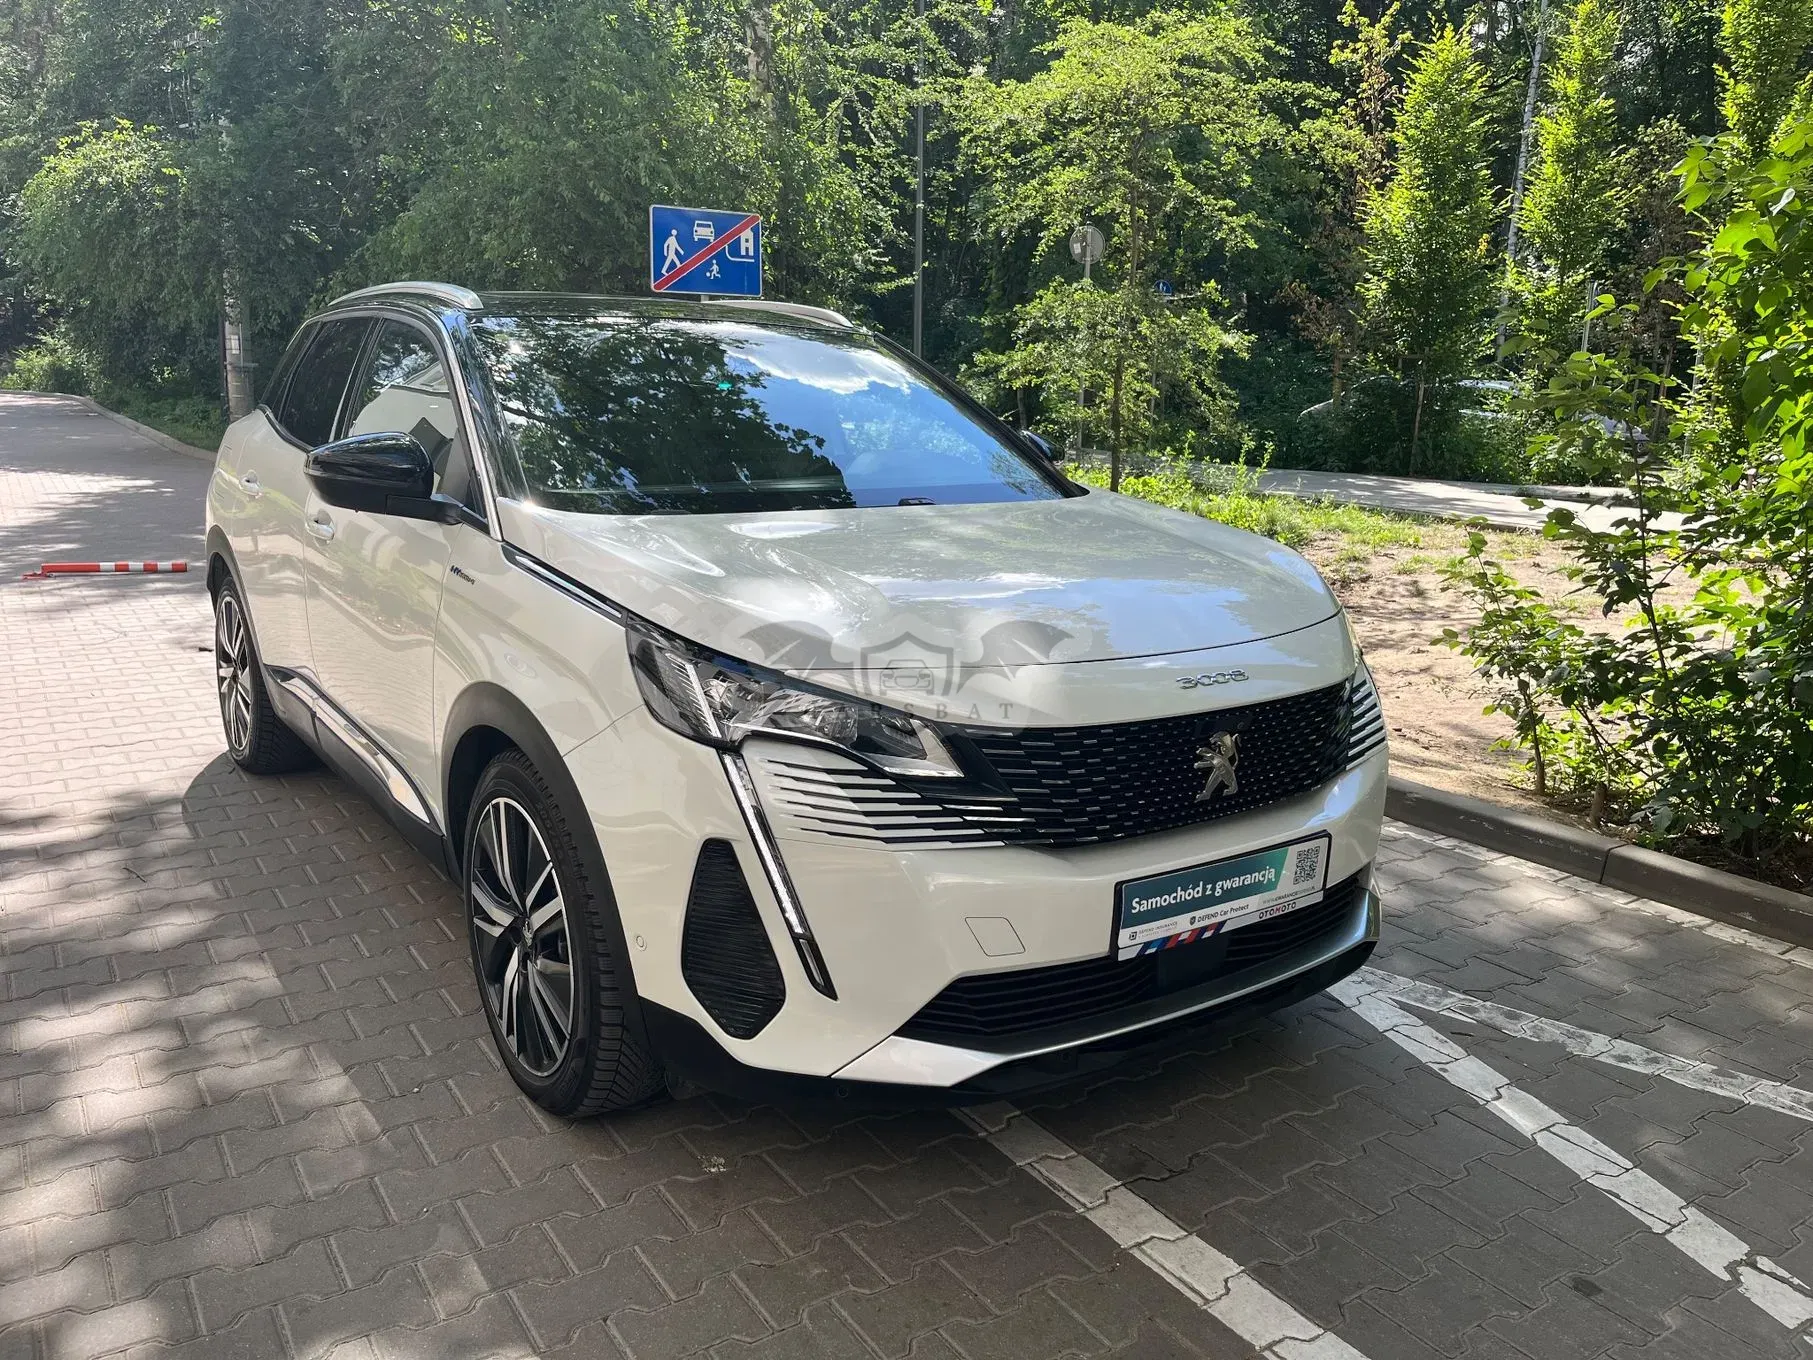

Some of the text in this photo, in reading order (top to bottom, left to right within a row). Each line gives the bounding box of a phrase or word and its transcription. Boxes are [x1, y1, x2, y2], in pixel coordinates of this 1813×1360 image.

[1176, 669, 1250, 689] 3008
[1131, 881, 1203, 914] Samochód
[1205, 883, 1213, 895] z
[1214, 865, 1276, 897] gwarancją
[1197, 903, 1250, 923] DEFEND Car Protect
[1258, 901, 1297, 920] OTOMOTO
